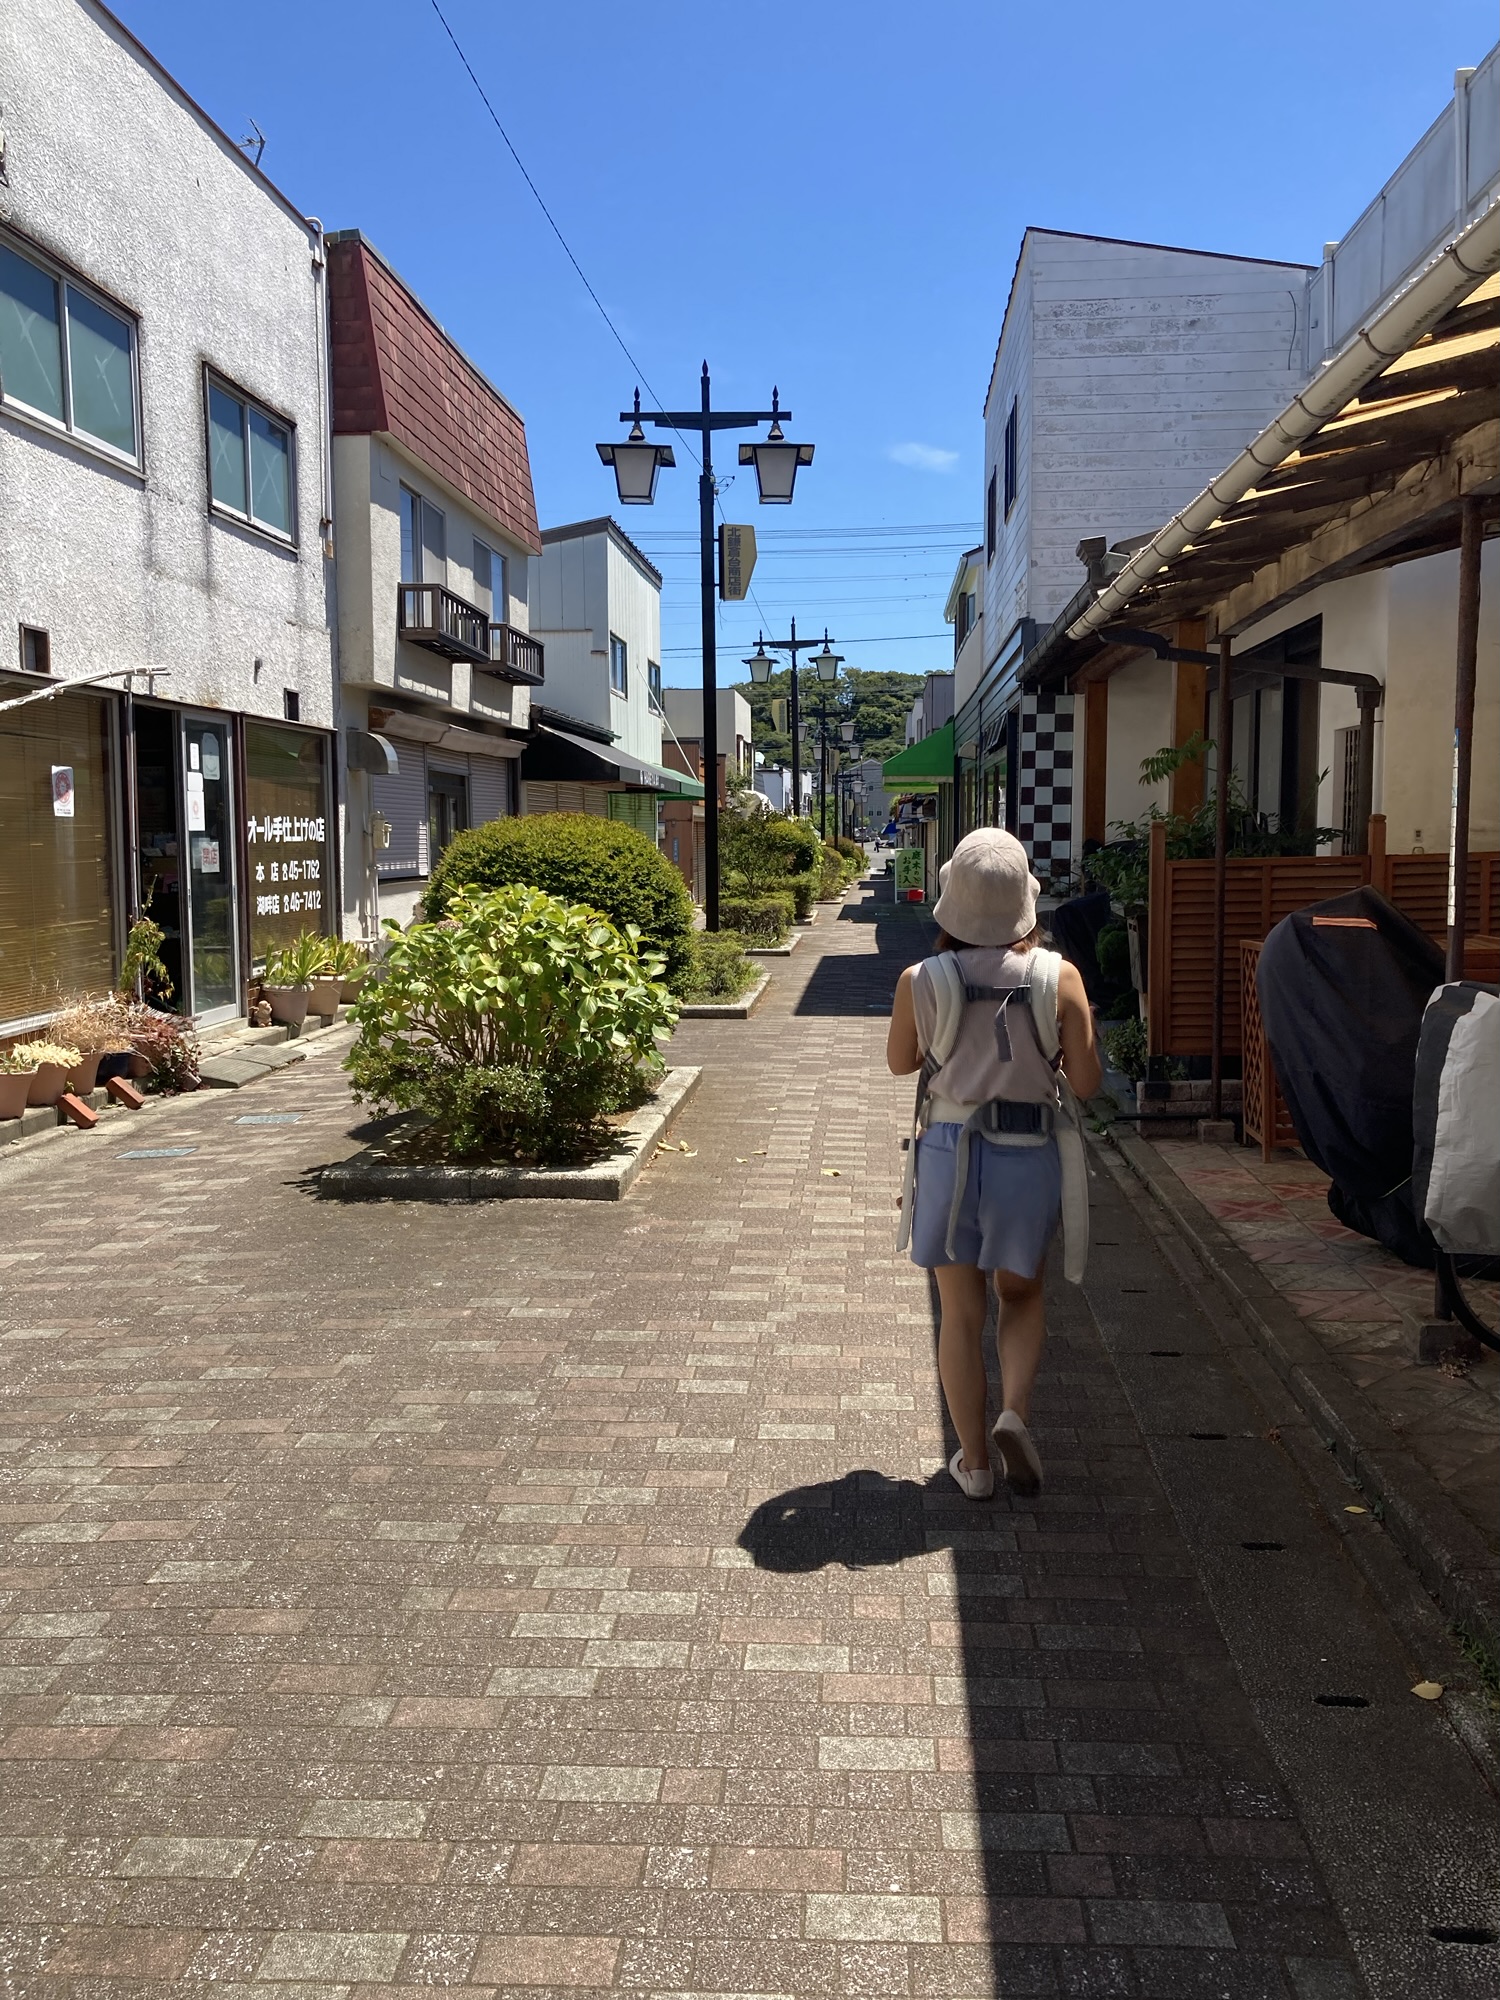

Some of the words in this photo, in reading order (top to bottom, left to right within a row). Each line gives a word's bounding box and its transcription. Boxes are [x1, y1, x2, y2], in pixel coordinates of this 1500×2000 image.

[247, 816, 325, 843] オール手仕上げの店
